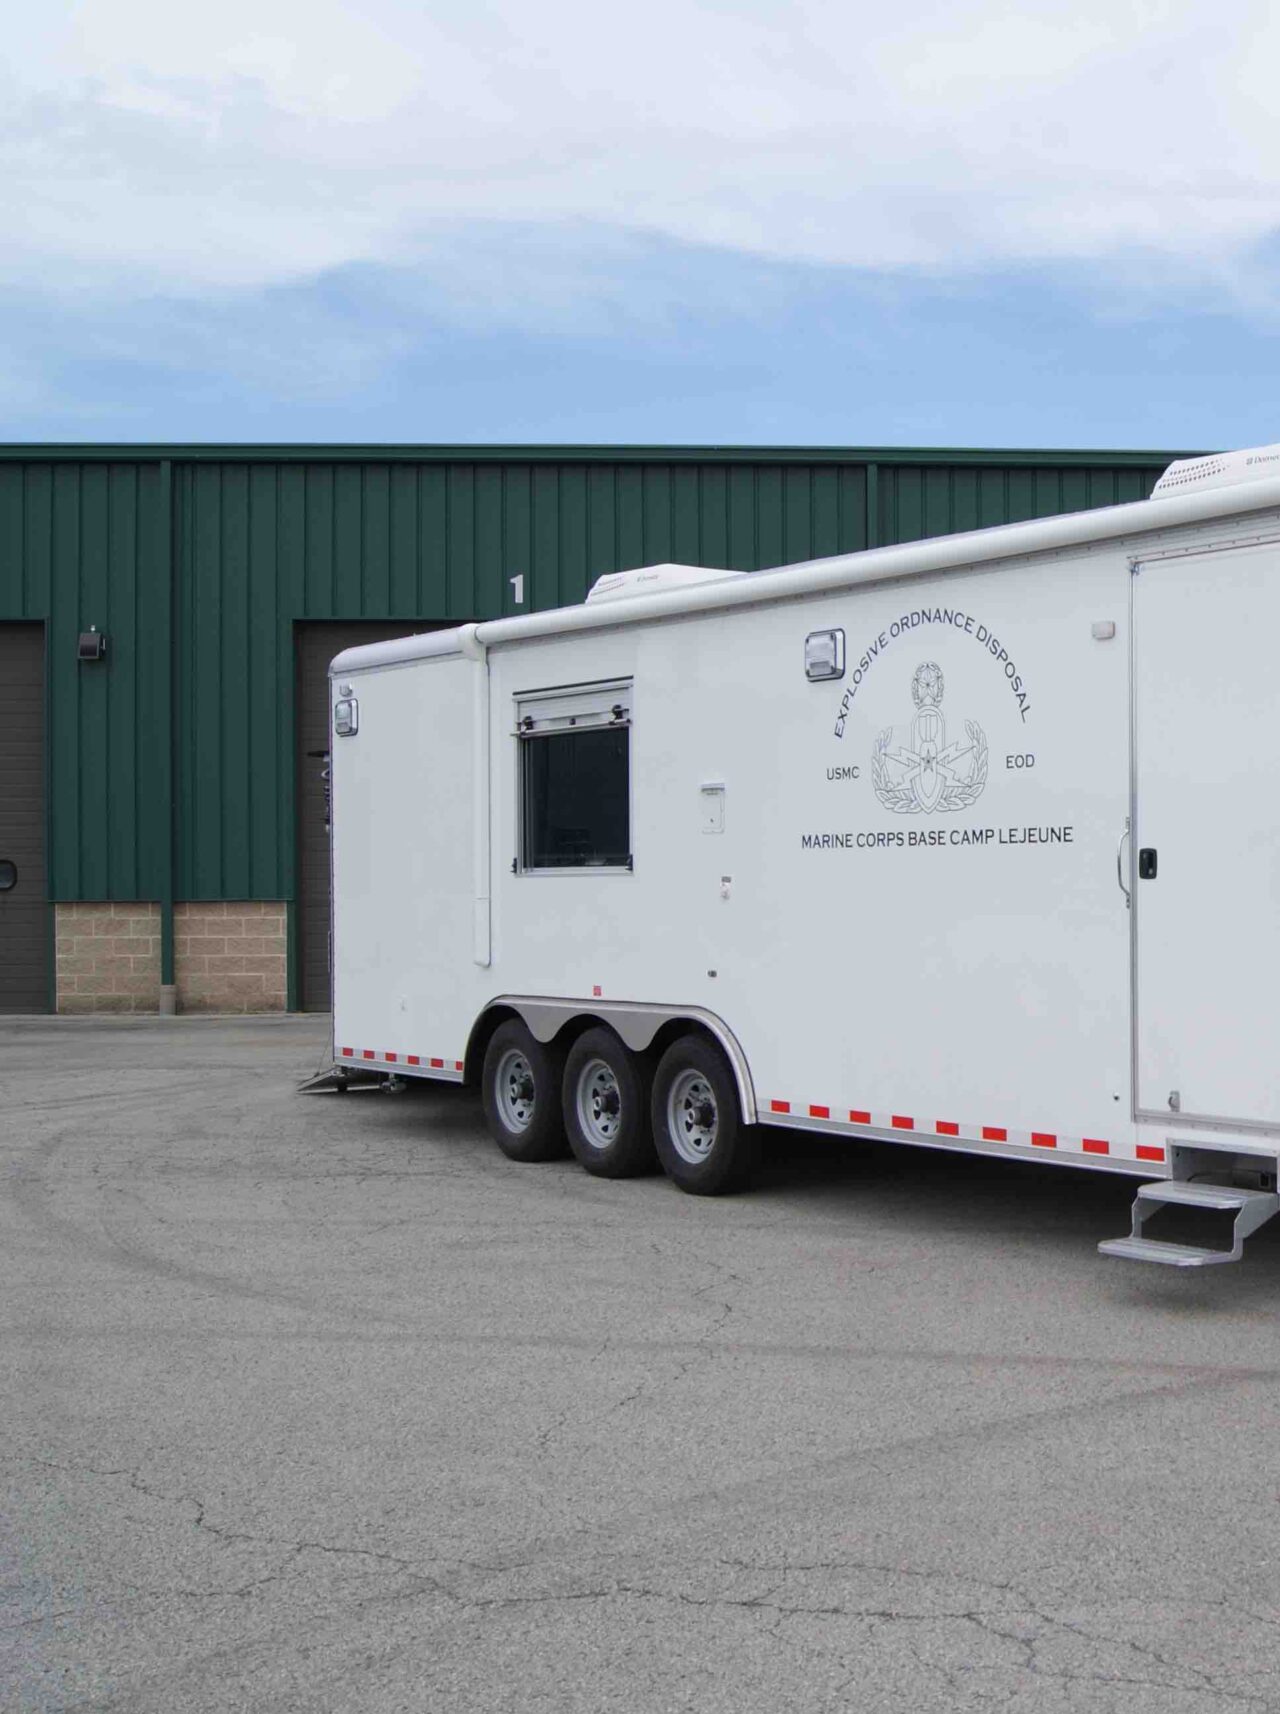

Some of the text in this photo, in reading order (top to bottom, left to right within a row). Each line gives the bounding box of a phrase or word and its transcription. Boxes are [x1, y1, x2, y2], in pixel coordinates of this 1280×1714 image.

[510, 574, 523, 603] 1
[834, 608, 1031, 739] EXPLOSIVE ORDNANCE DISPOSAL
[826, 766, 860, 780] USMC
[1005, 754, 1036, 769] EOD
[801, 826, 1074, 849] MARINE CORPS BASE CAMP LEJEUNE
